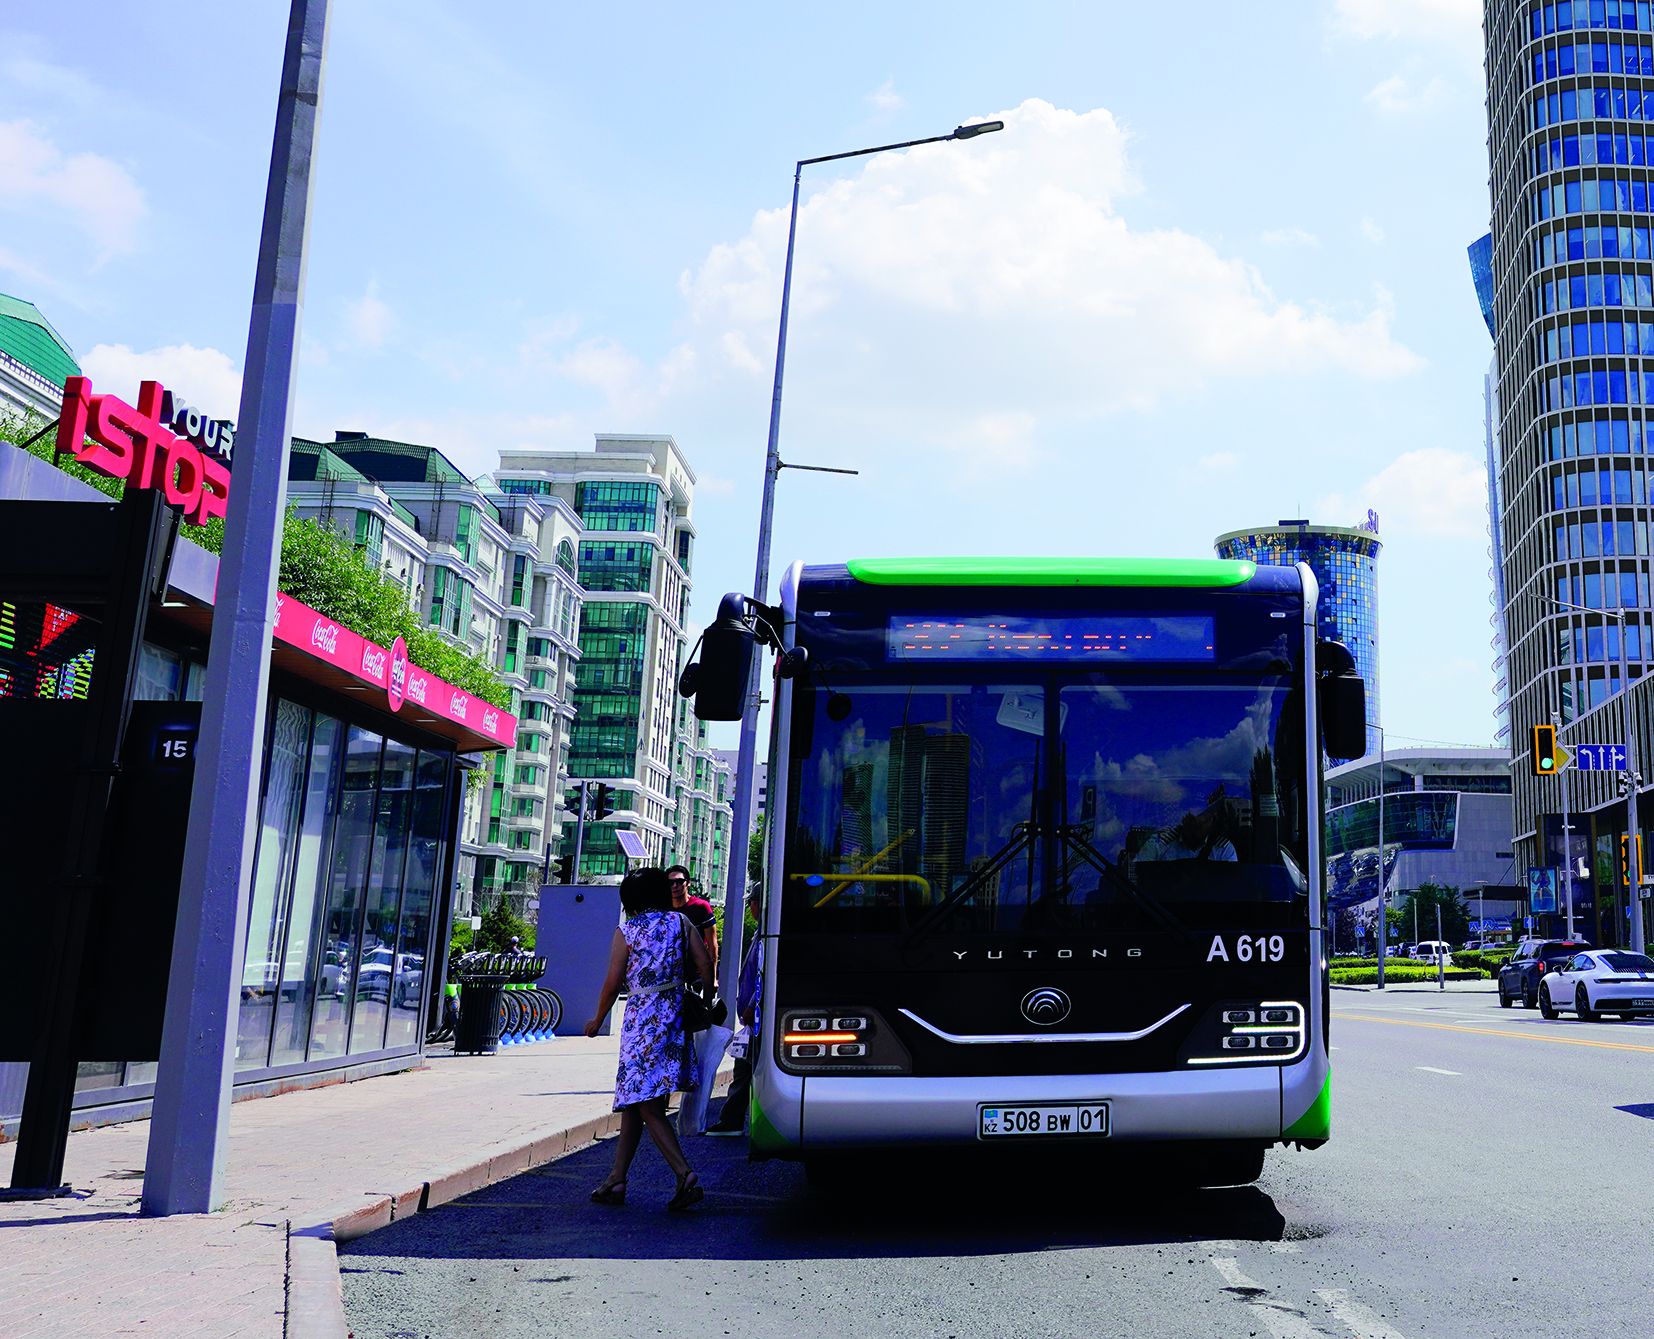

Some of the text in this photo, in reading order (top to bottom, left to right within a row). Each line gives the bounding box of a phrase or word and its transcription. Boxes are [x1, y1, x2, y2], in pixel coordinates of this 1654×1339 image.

[161, 390, 235, 461] YOUR
[162, 740, 188, 758] 15
[953, 948, 1143, 960] YUTONG
[1236, 934, 1286, 962] 619
[984, 1108, 1105, 1133] KZ 508 BW 01
